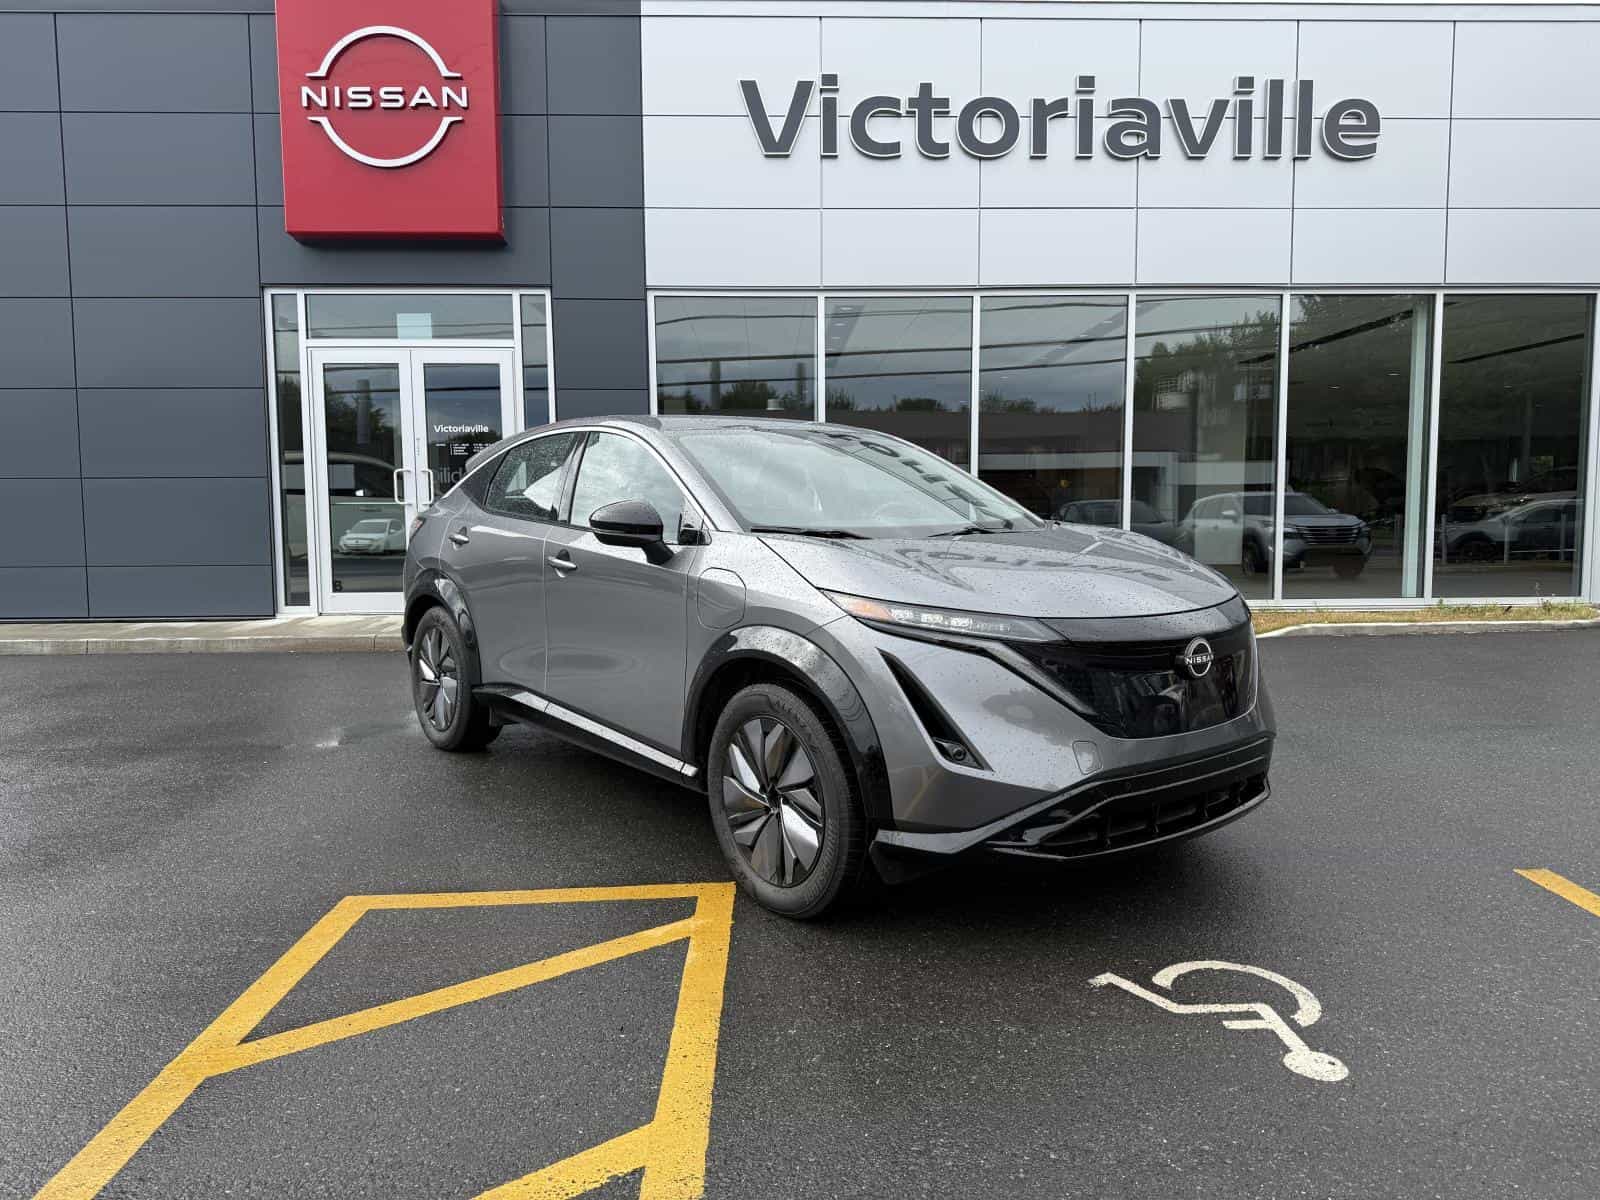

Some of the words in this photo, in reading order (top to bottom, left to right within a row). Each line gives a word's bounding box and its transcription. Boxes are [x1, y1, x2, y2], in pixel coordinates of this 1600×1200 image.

[300, 85, 469, 109] NISSAN
[738, 73, 1381, 159] Victoriaville
[434, 424, 489, 433] Victoriaville
